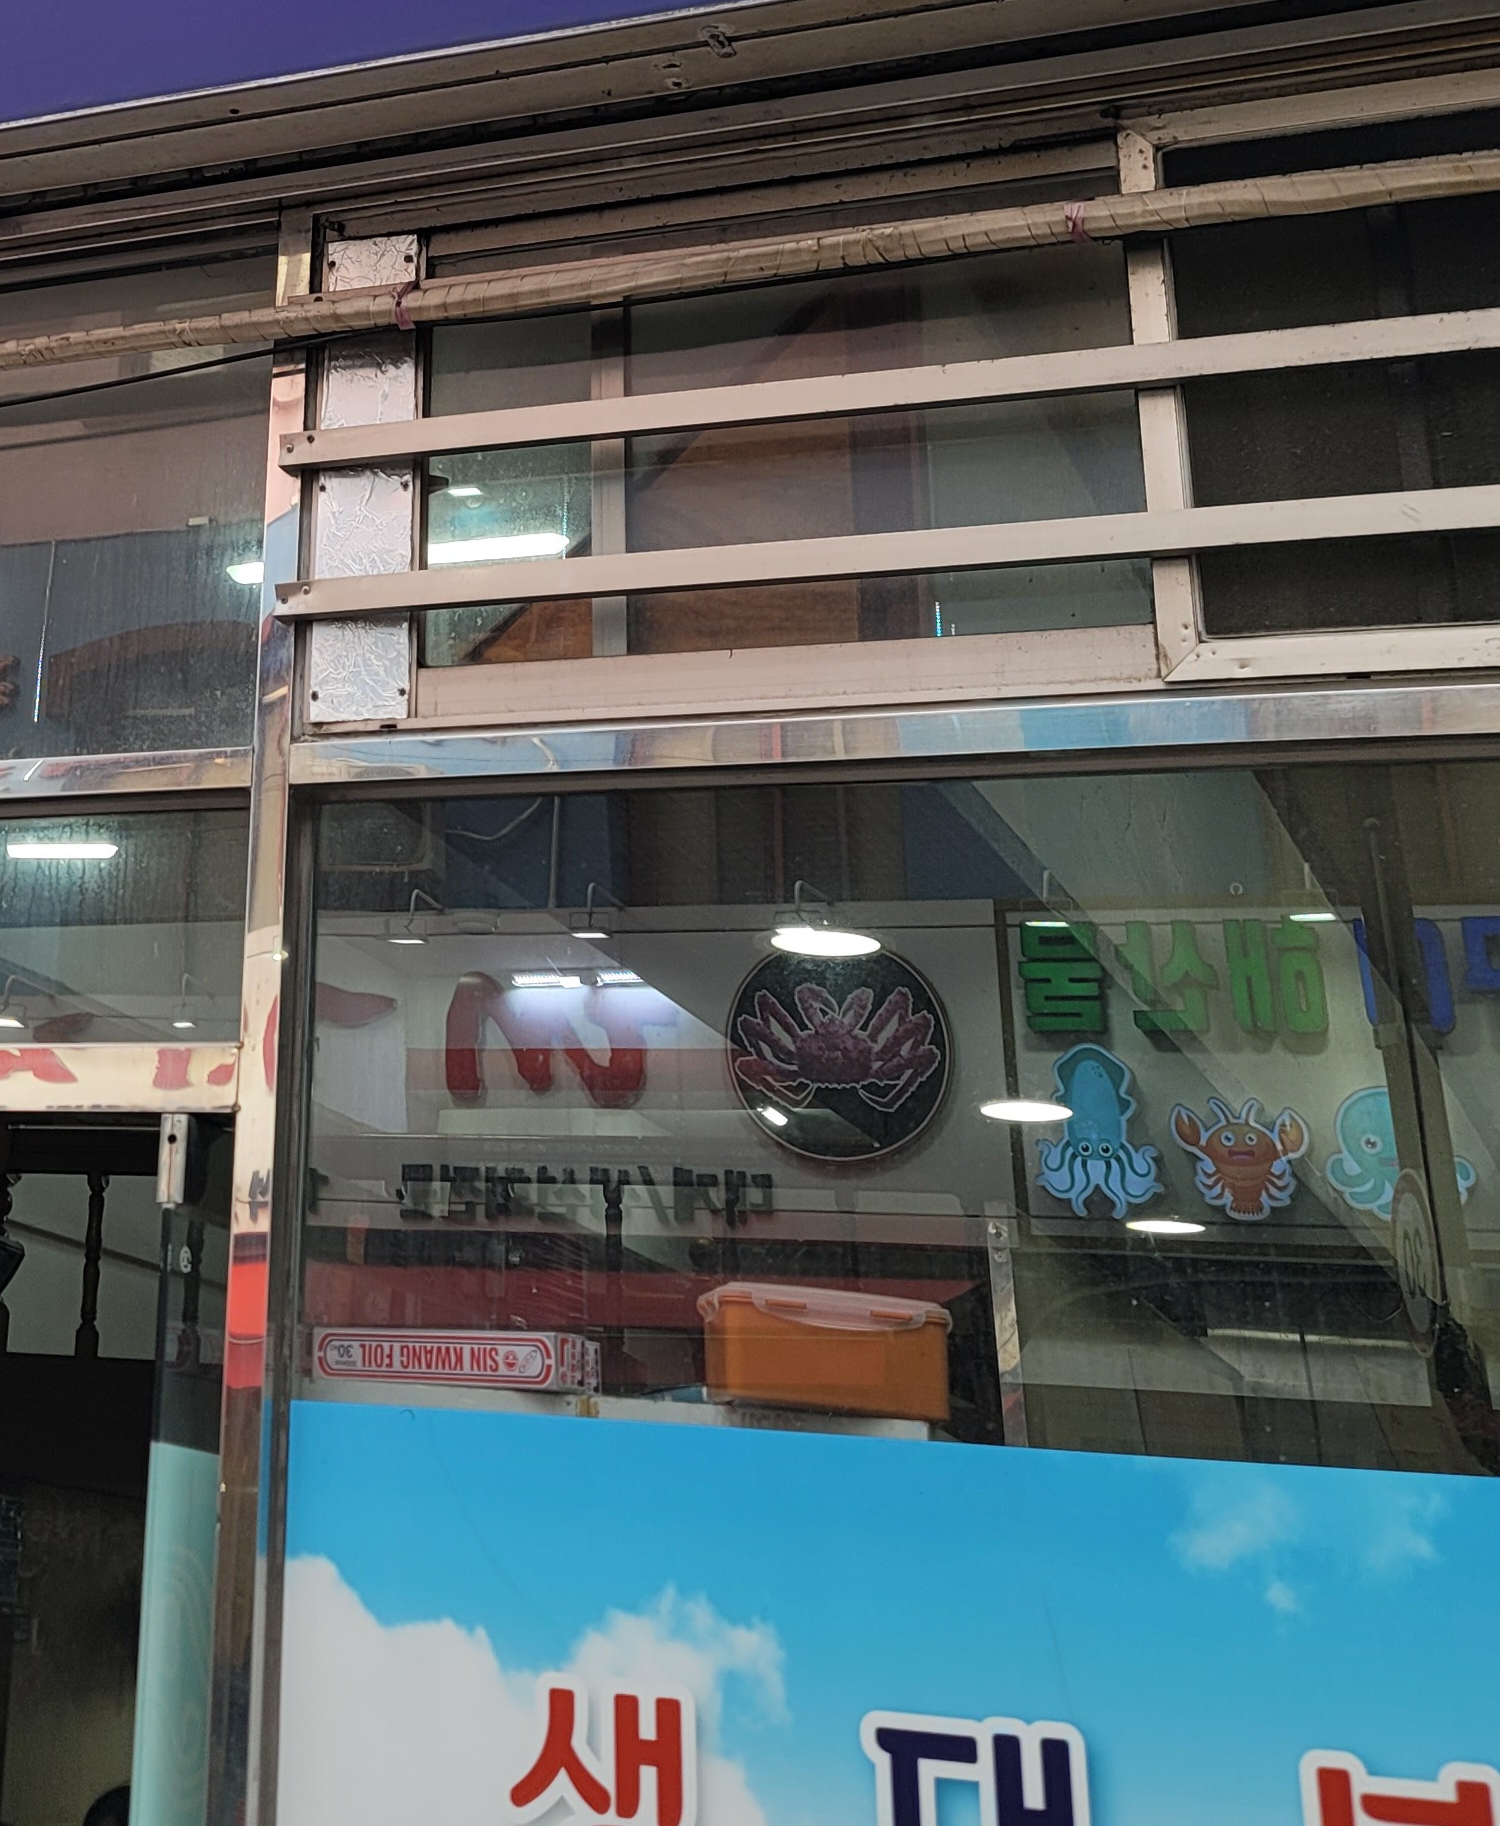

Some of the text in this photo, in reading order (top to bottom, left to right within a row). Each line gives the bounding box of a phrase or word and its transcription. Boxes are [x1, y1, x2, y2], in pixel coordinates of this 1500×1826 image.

[359, 1343, 500, 1372] SIN KWANG FOIL
